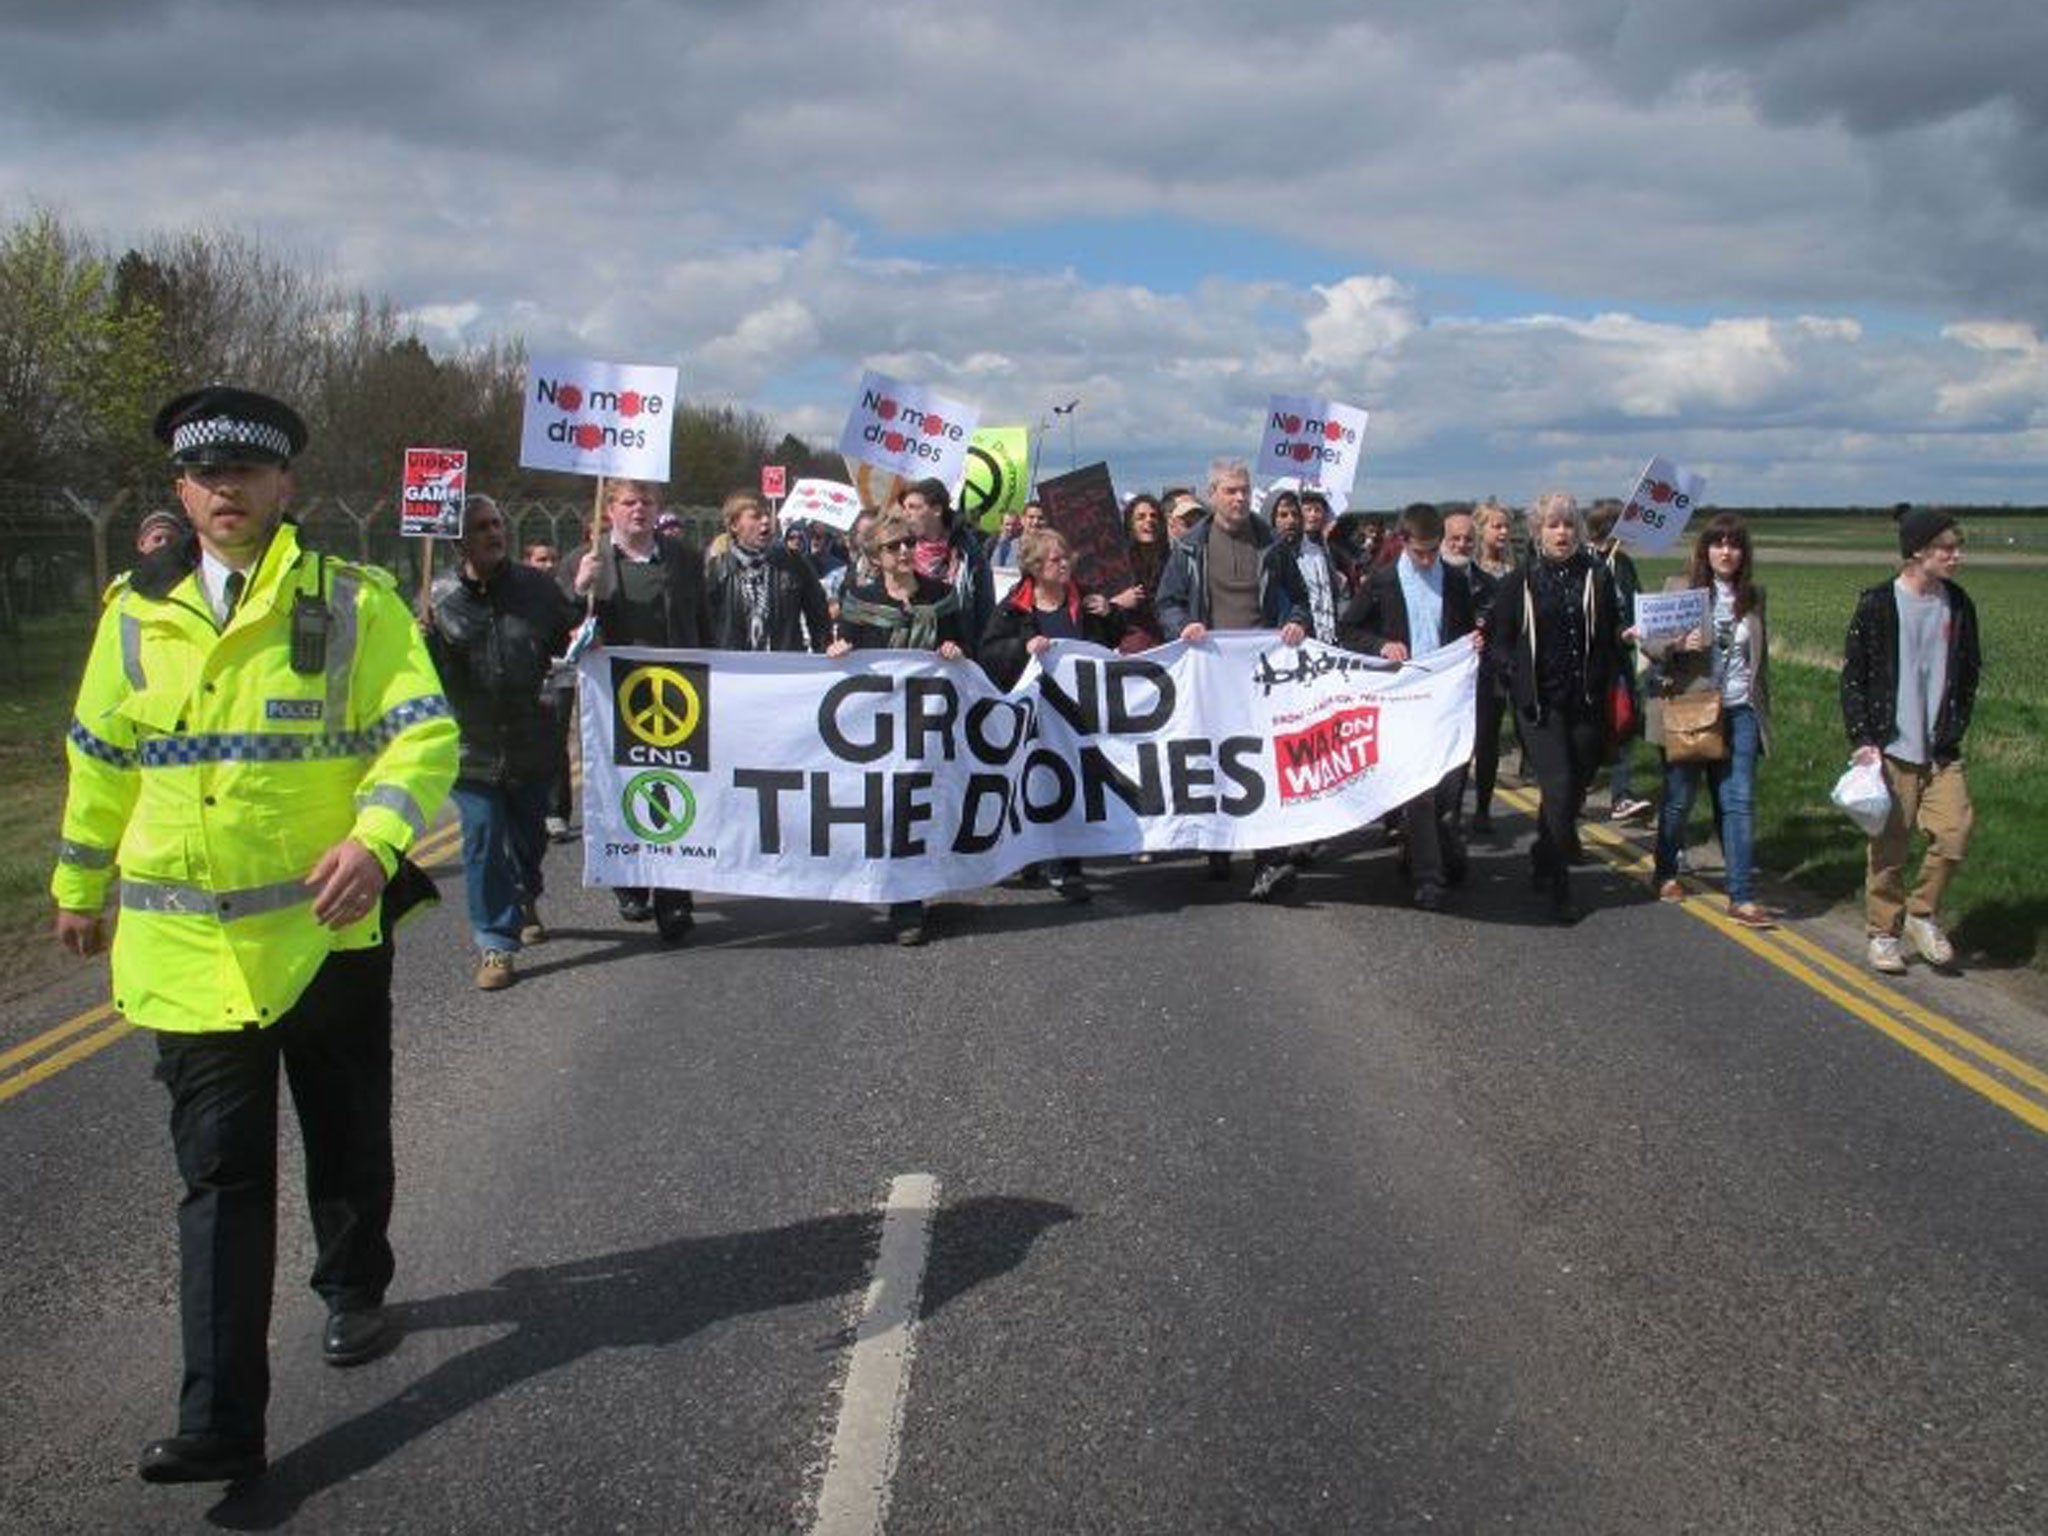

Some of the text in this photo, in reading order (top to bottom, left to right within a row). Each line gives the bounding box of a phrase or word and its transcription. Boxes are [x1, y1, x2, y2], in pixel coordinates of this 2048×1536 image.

[537, 377, 663, 418] No more
[861, 389, 963, 441] No more
[1272, 412, 1356, 444] No more
[547, 418, 645, 451] drones
[864, 424, 941, 463] drones
[269, 702, 319, 716] POLICE
[1340, 714, 1374, 737] ON
[629, 745, 692, 767] CND
[1285, 735, 1374, 793] WANT
[733, 768, 933, 859] THE
[605, 843, 717, 859] STOP THE WAR
